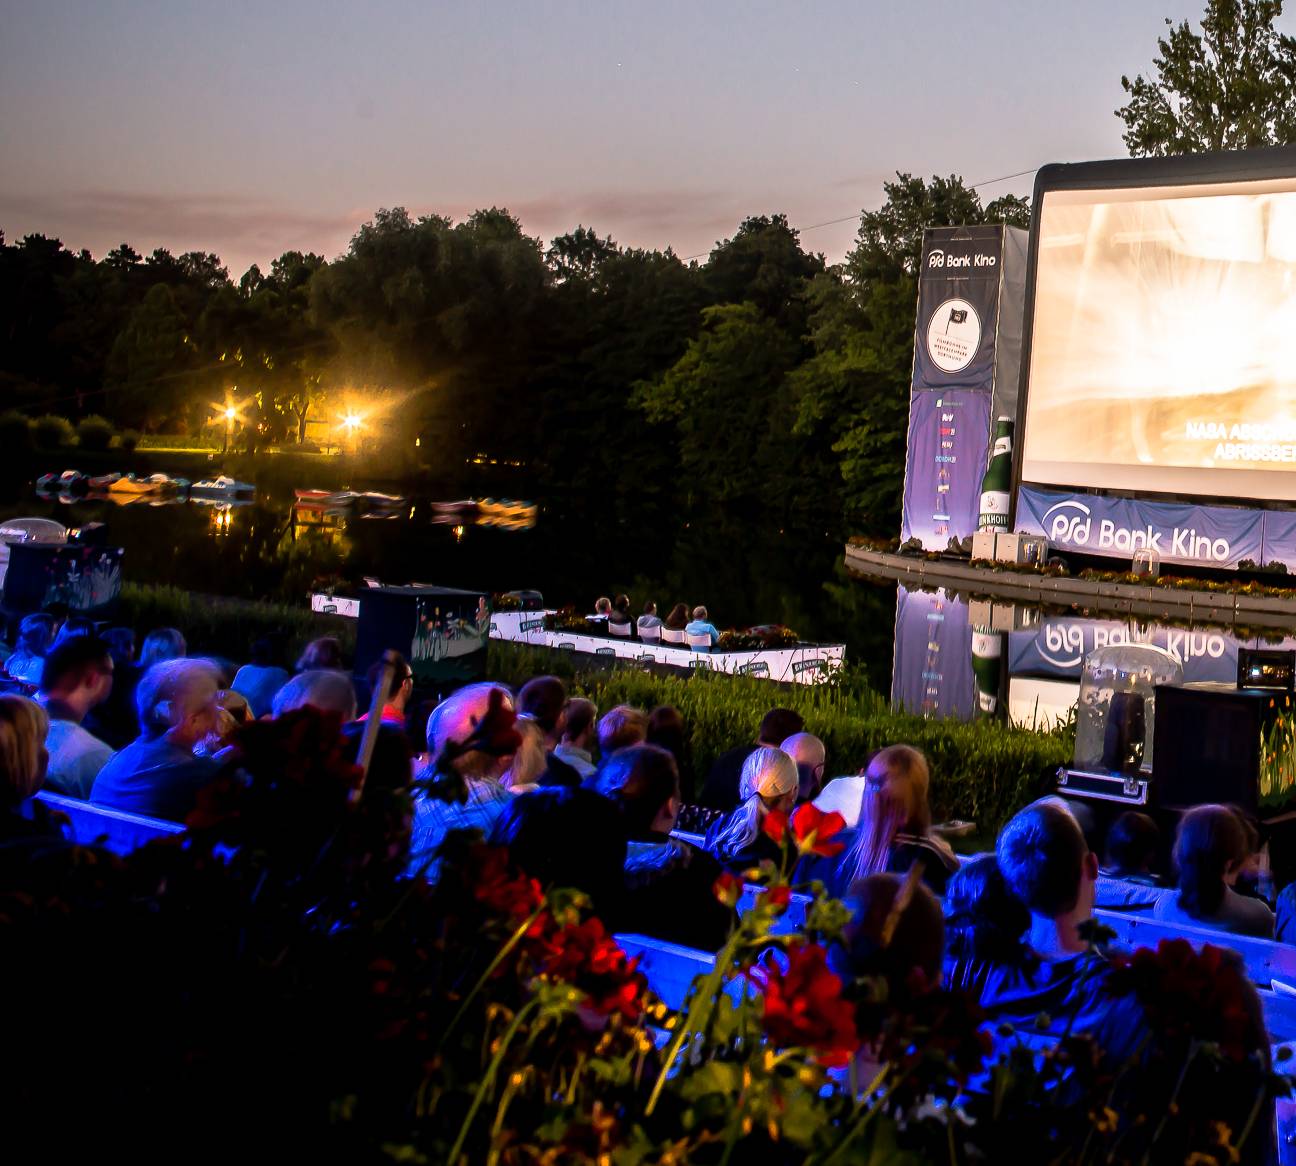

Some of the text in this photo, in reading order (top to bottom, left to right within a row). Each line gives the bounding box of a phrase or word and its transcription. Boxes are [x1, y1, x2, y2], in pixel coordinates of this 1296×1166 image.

[947, 254, 970, 267] Bank
[974, 253, 996, 267] Kino
[1185, 421, 1227, 440] NASA
[1098, 518, 1162, 551] Bank
[1171, 527, 1230, 561] Kino
